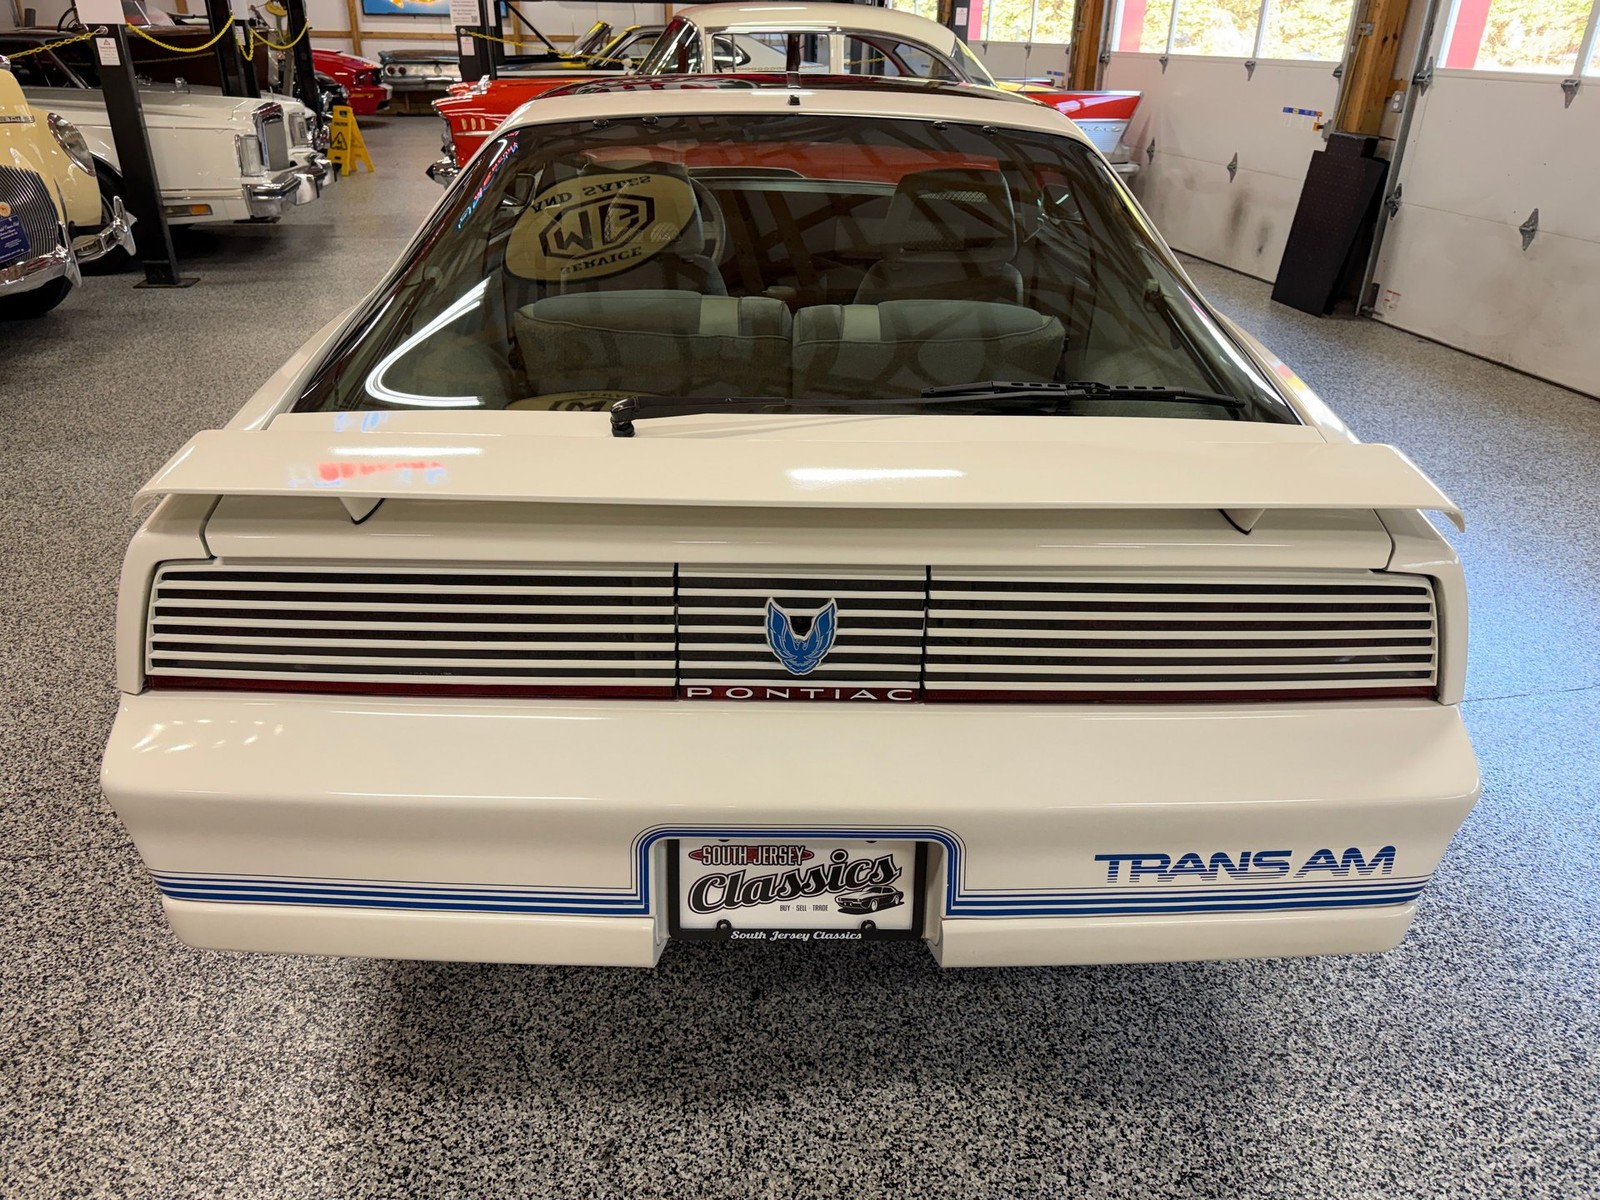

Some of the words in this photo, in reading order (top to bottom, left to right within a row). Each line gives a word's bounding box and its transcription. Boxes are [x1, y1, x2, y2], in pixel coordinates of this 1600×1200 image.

[686, 687, 913, 701] PONTIAC
[702, 845, 748, 866] SOUTH
[753, 845, 807, 866] JERSEY
[1094, 850, 1292, 883] TRANS
[1293, 845, 1397, 878] AM
[688, 849, 902, 914] Classics
[779, 904, 791, 913] BUY
[796, 904, 807, 913] SELL
[812, 904, 828, 913] TRADE
[730, 930, 767, 941] South
[769, 930, 811, 942] Jersey
[813, 930, 862, 941] Classics
